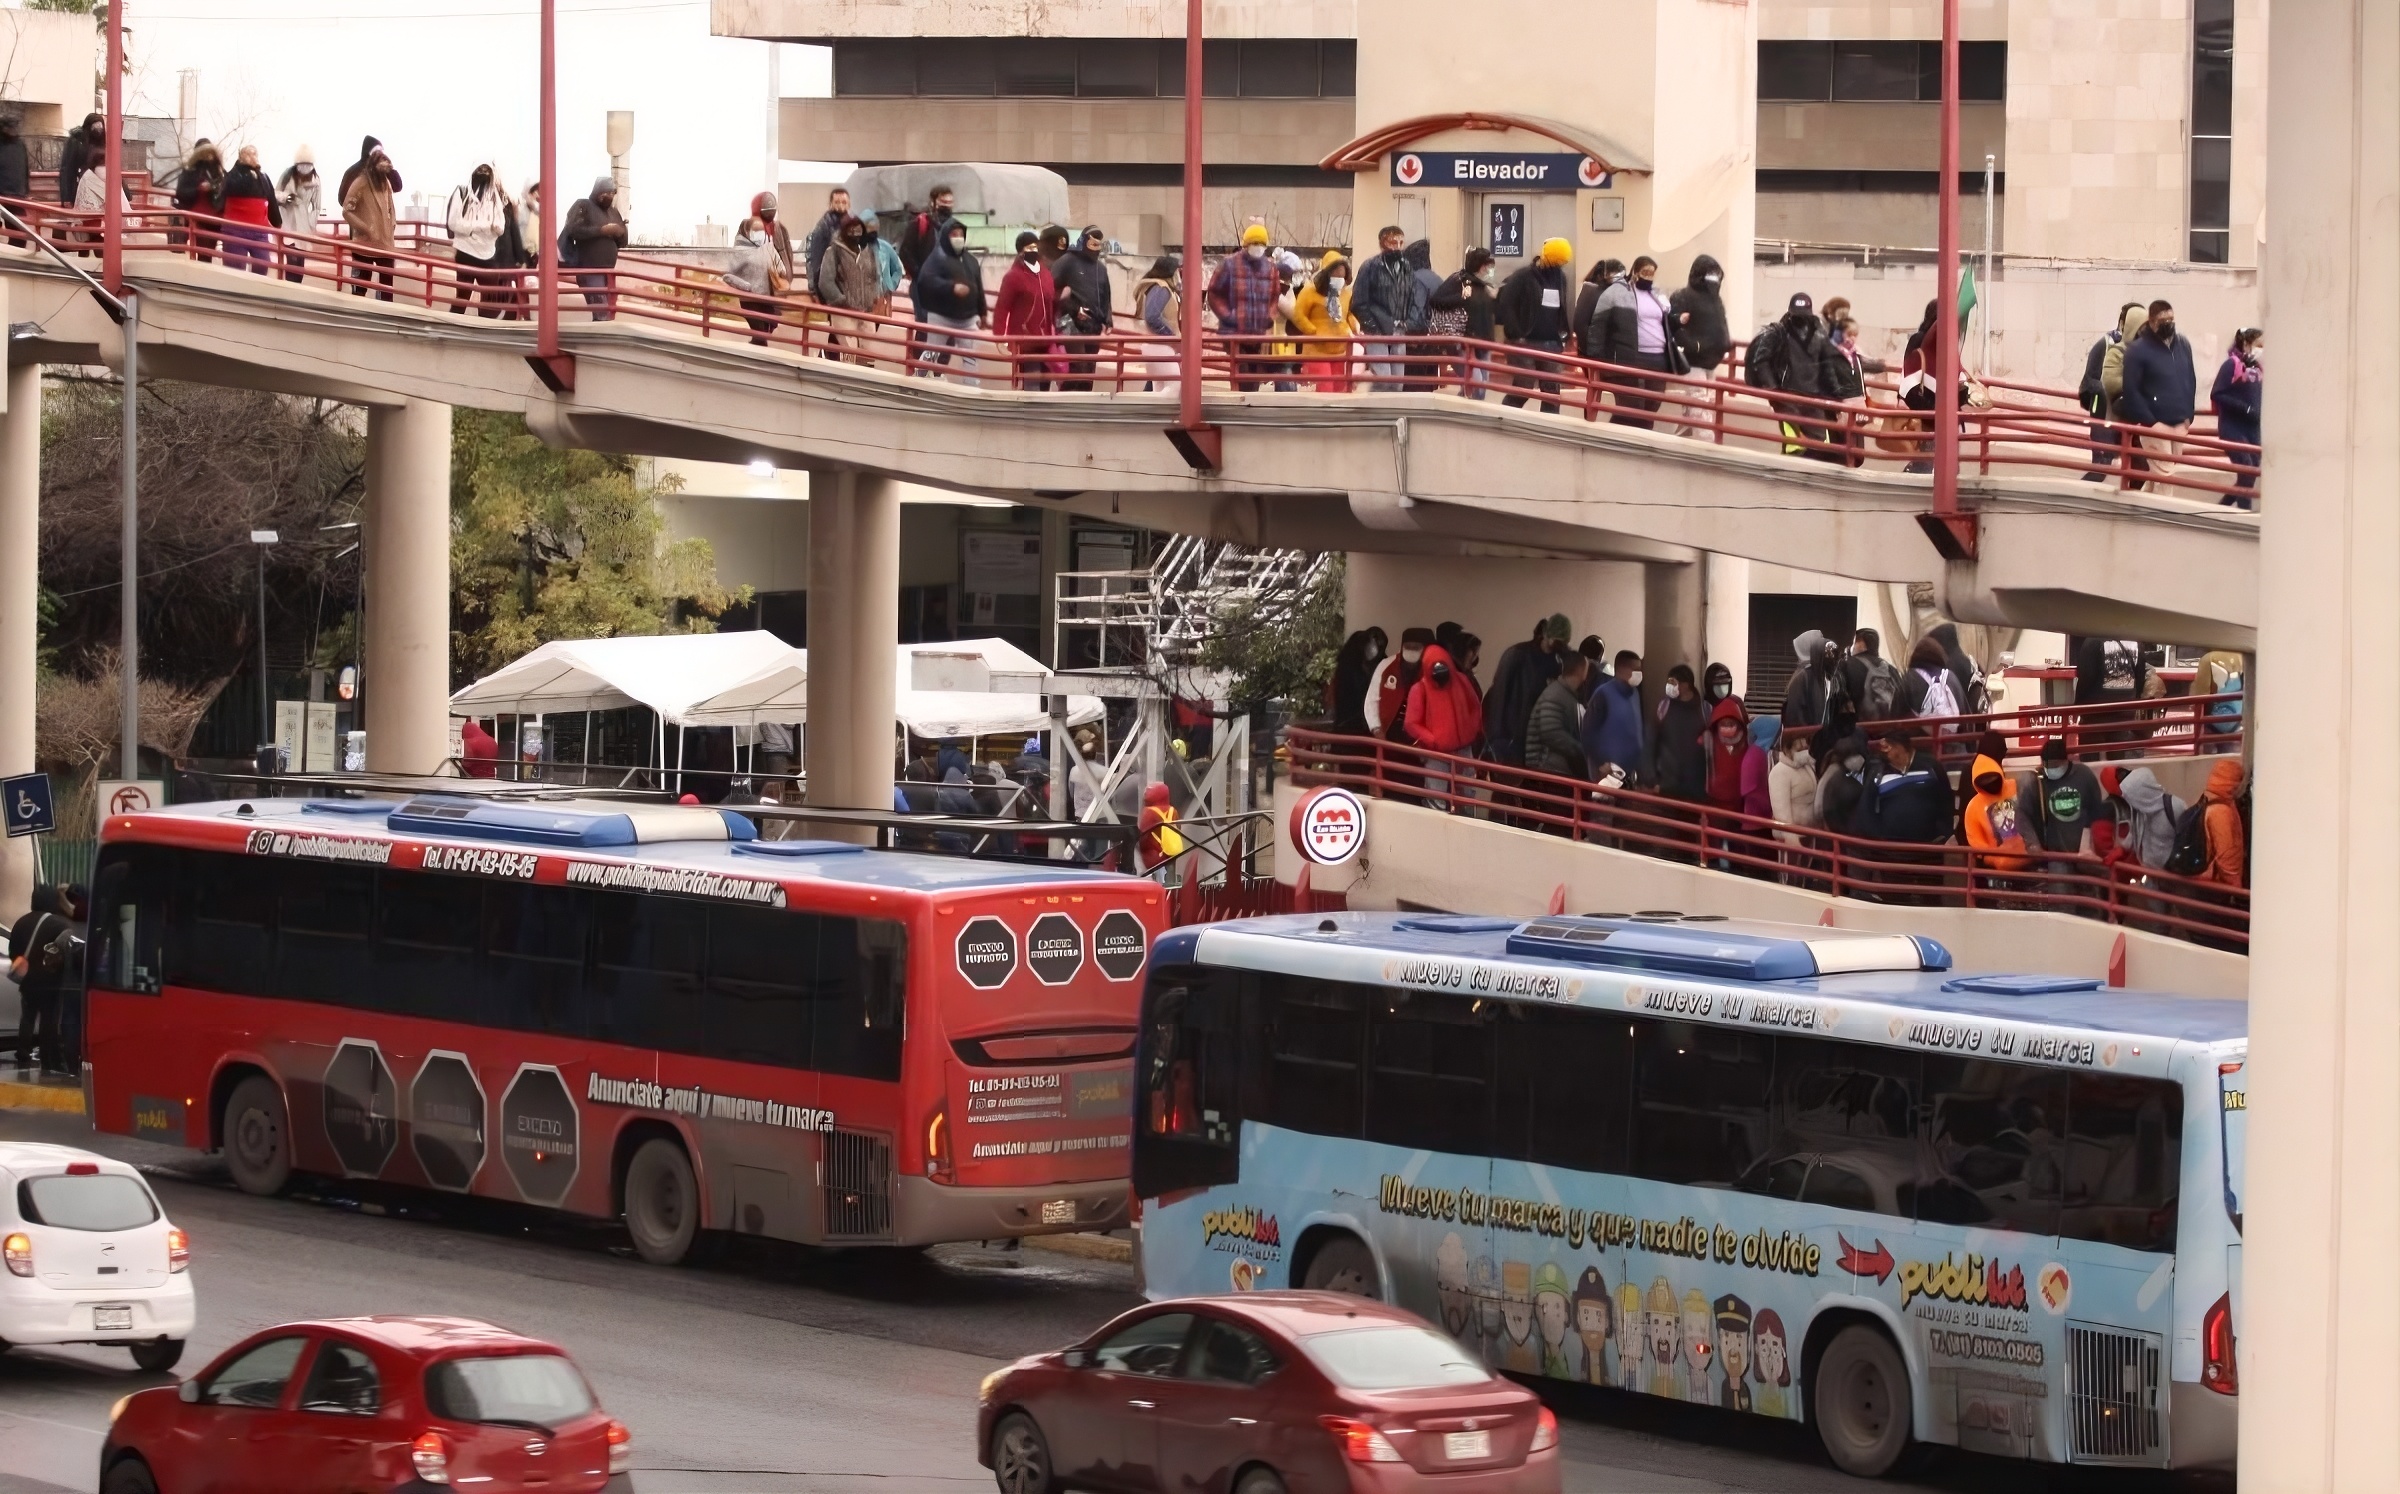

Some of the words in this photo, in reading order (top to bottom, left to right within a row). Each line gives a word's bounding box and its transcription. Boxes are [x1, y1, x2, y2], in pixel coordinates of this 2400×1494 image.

[1454, 159, 1549, 180] Elevador
[1379, 1173, 1457, 1223] Mueve
[1459, 1186, 1486, 1226] tu
[1490, 1196, 1565, 1237] marca
[1568, 1207, 1586, 1249] y
[1588, 1211, 1638, 1253] que
[1640, 1215, 1708, 1260] nadie
[1713, 1222, 1738, 1265] te
[1741, 1226, 1821, 1277] olvide
